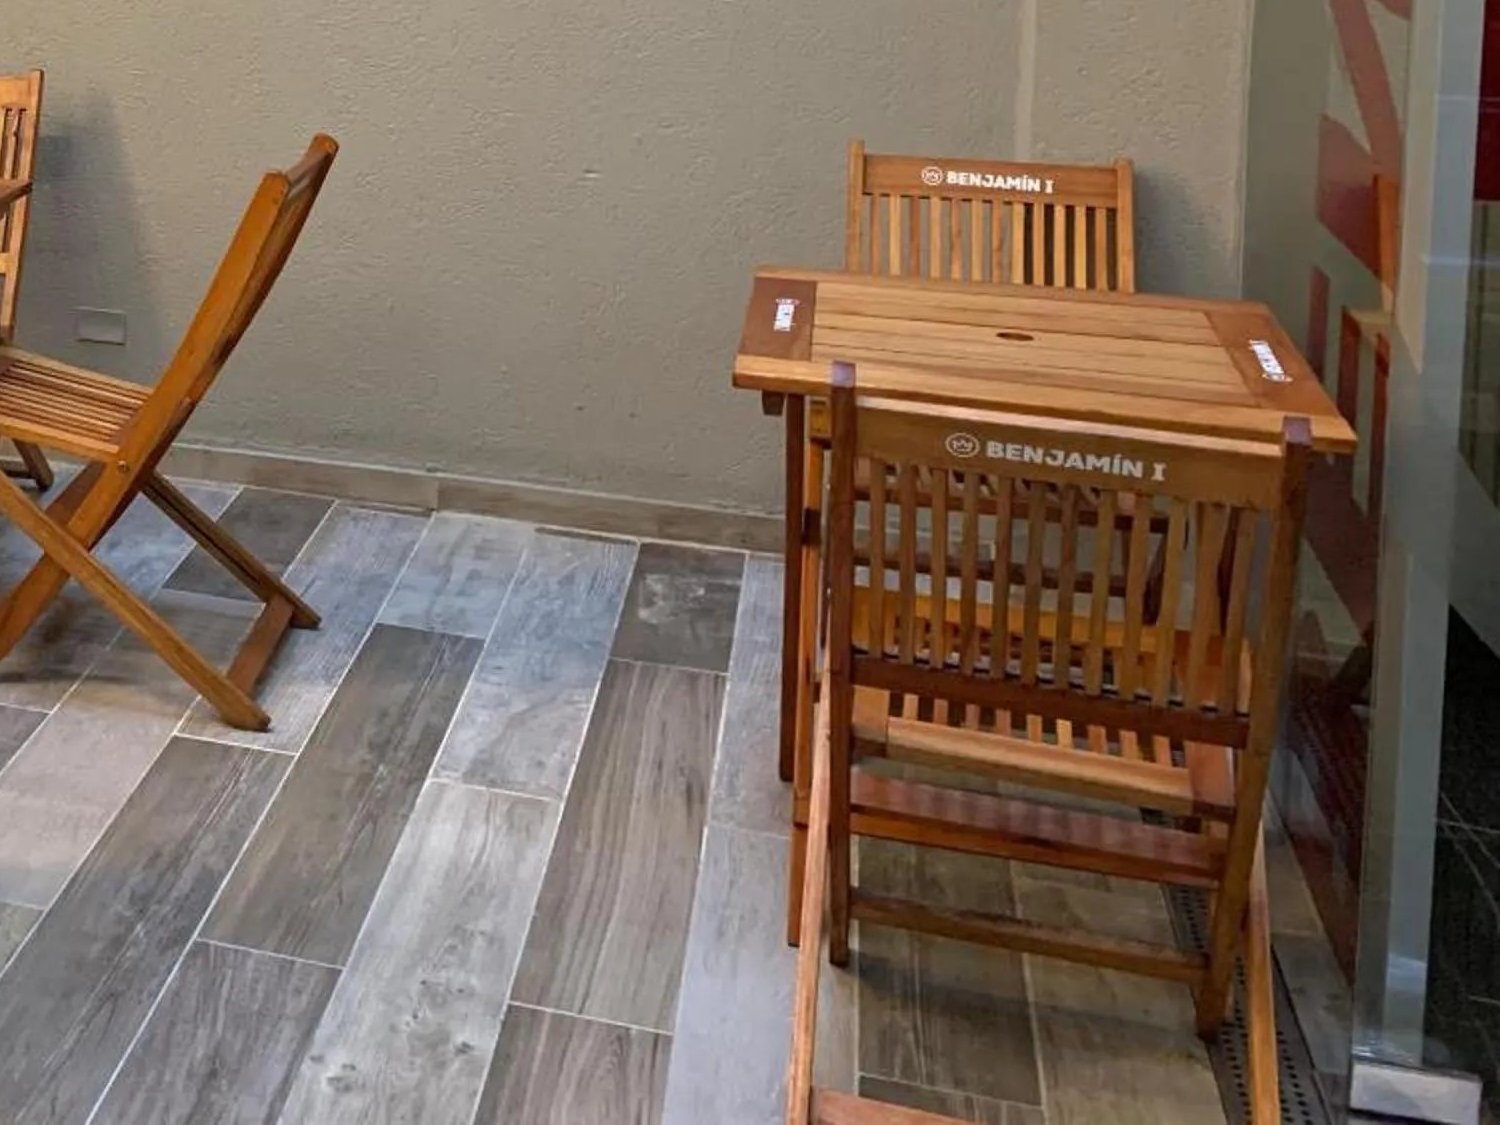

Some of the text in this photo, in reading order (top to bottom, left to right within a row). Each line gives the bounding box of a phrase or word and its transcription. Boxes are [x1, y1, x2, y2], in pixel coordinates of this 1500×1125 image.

[946, 170, 1055, 194] BENJAMÍN I
[986, 440, 1168, 482] BENJAMÍN I
